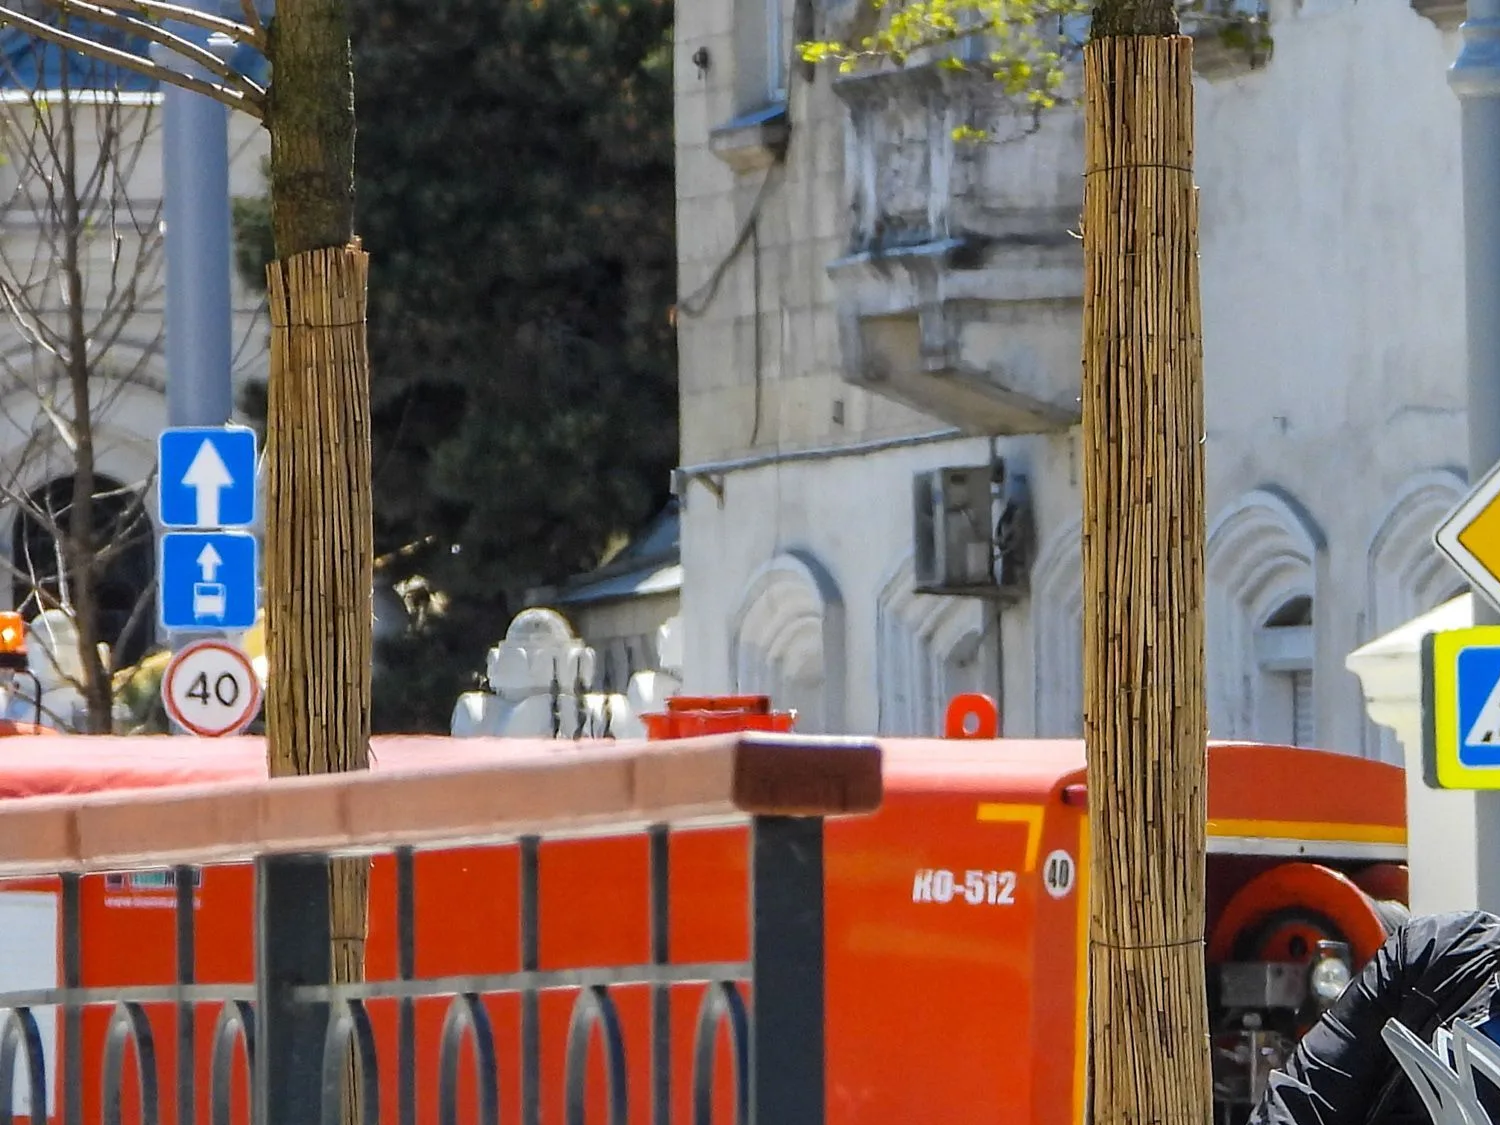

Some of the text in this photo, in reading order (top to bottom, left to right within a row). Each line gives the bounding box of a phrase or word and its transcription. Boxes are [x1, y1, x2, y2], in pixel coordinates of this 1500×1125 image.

[186, 672, 239, 707] 40
[912, 868, 1017, 905] КО-512
[1048, 858, 1070, 888] 40
